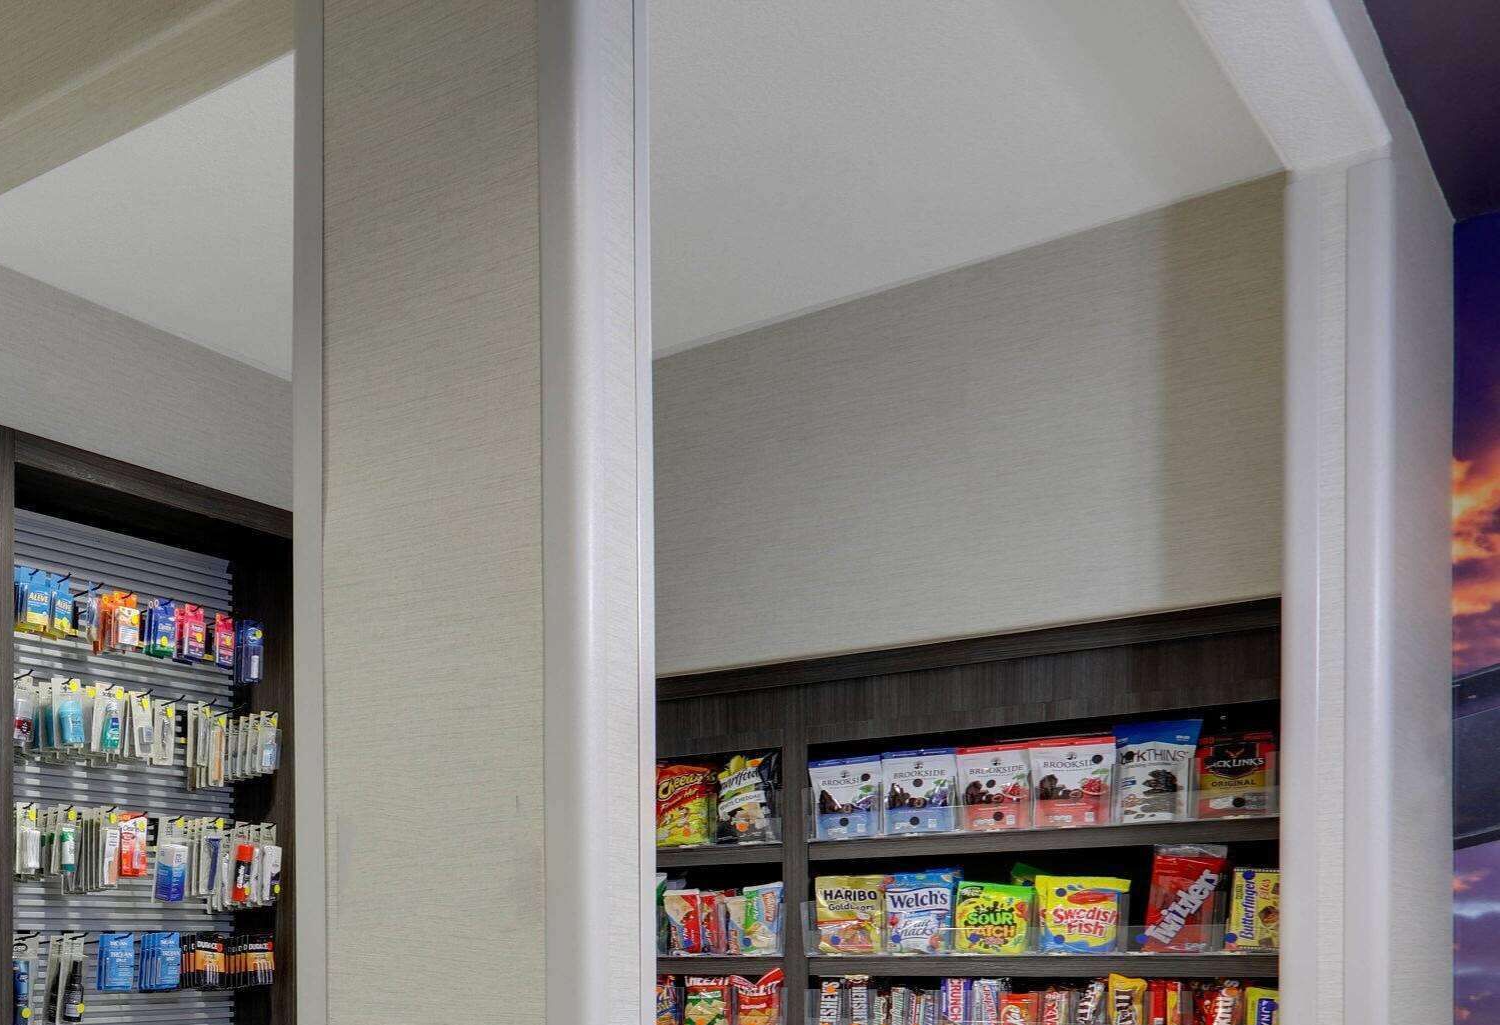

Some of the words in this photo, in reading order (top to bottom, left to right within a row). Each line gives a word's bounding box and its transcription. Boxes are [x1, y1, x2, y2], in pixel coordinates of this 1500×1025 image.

[1043, 758, 1098, 769] BROOKSI
[893, 769, 946, 780] BROOKSIDE
[821, 776, 866, 788] BROOKSI
[1211, 779, 1257, 788] ORIGINAL
[823, 889, 877, 901] HARIBO
[889, 890, 948, 909] Welch's
[967, 911, 1013, 926] SOUR
[1052, 906, 1121, 924] Swedish
[1067, 922, 1106, 938] Fish
